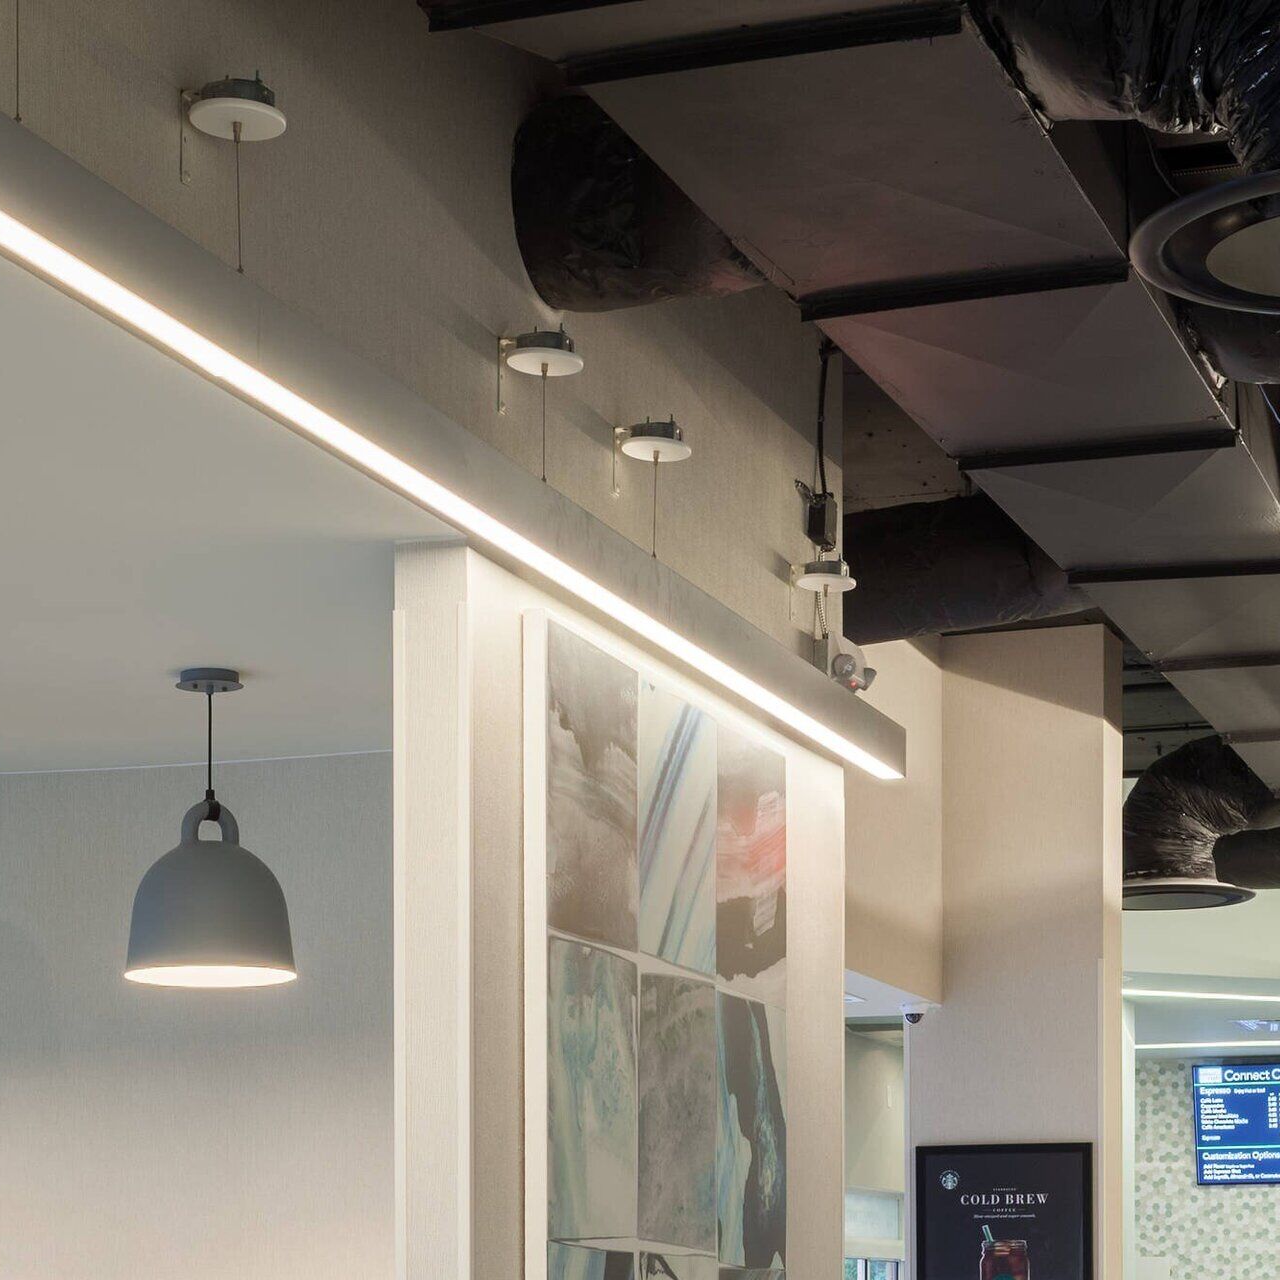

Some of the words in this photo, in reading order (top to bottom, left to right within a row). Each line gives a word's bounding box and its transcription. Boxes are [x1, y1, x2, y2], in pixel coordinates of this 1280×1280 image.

[1224, 1069, 1270, 1081] Connect
[1200, 1087, 1232, 1097] Espresso
[1202, 1152, 1251, 1161] Customization
[1252, 1151, 1280, 1162] Options
[960, 1194, 1000, 1206] COLD
[1005, 1193, 1049, 1205] BREW
